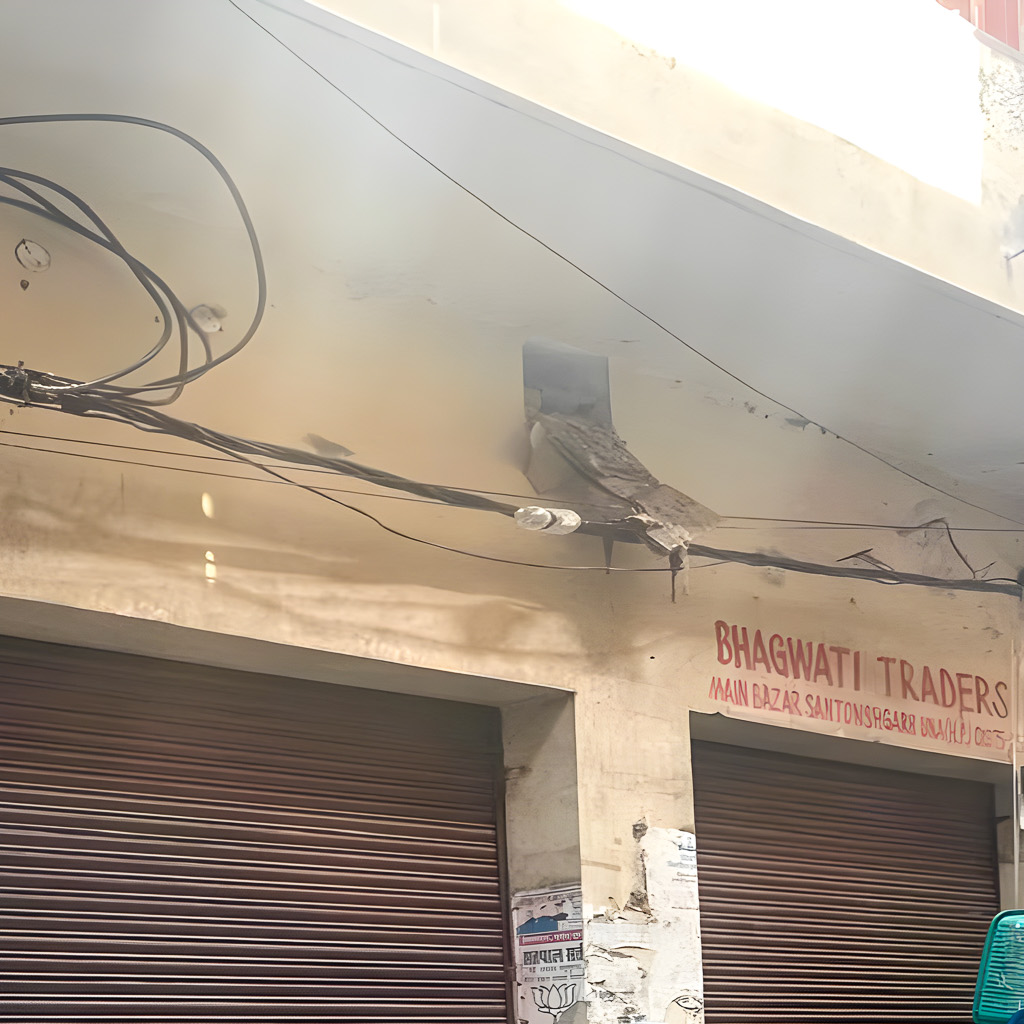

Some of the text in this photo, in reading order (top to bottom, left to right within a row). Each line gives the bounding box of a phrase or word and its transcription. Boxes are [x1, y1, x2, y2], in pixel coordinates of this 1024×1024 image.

[708, 676, 749, 707] MAIN
[752, 683, 802, 716] BAZAR
[714, 620, 1008, 718] BHAGWATI TRADERS
